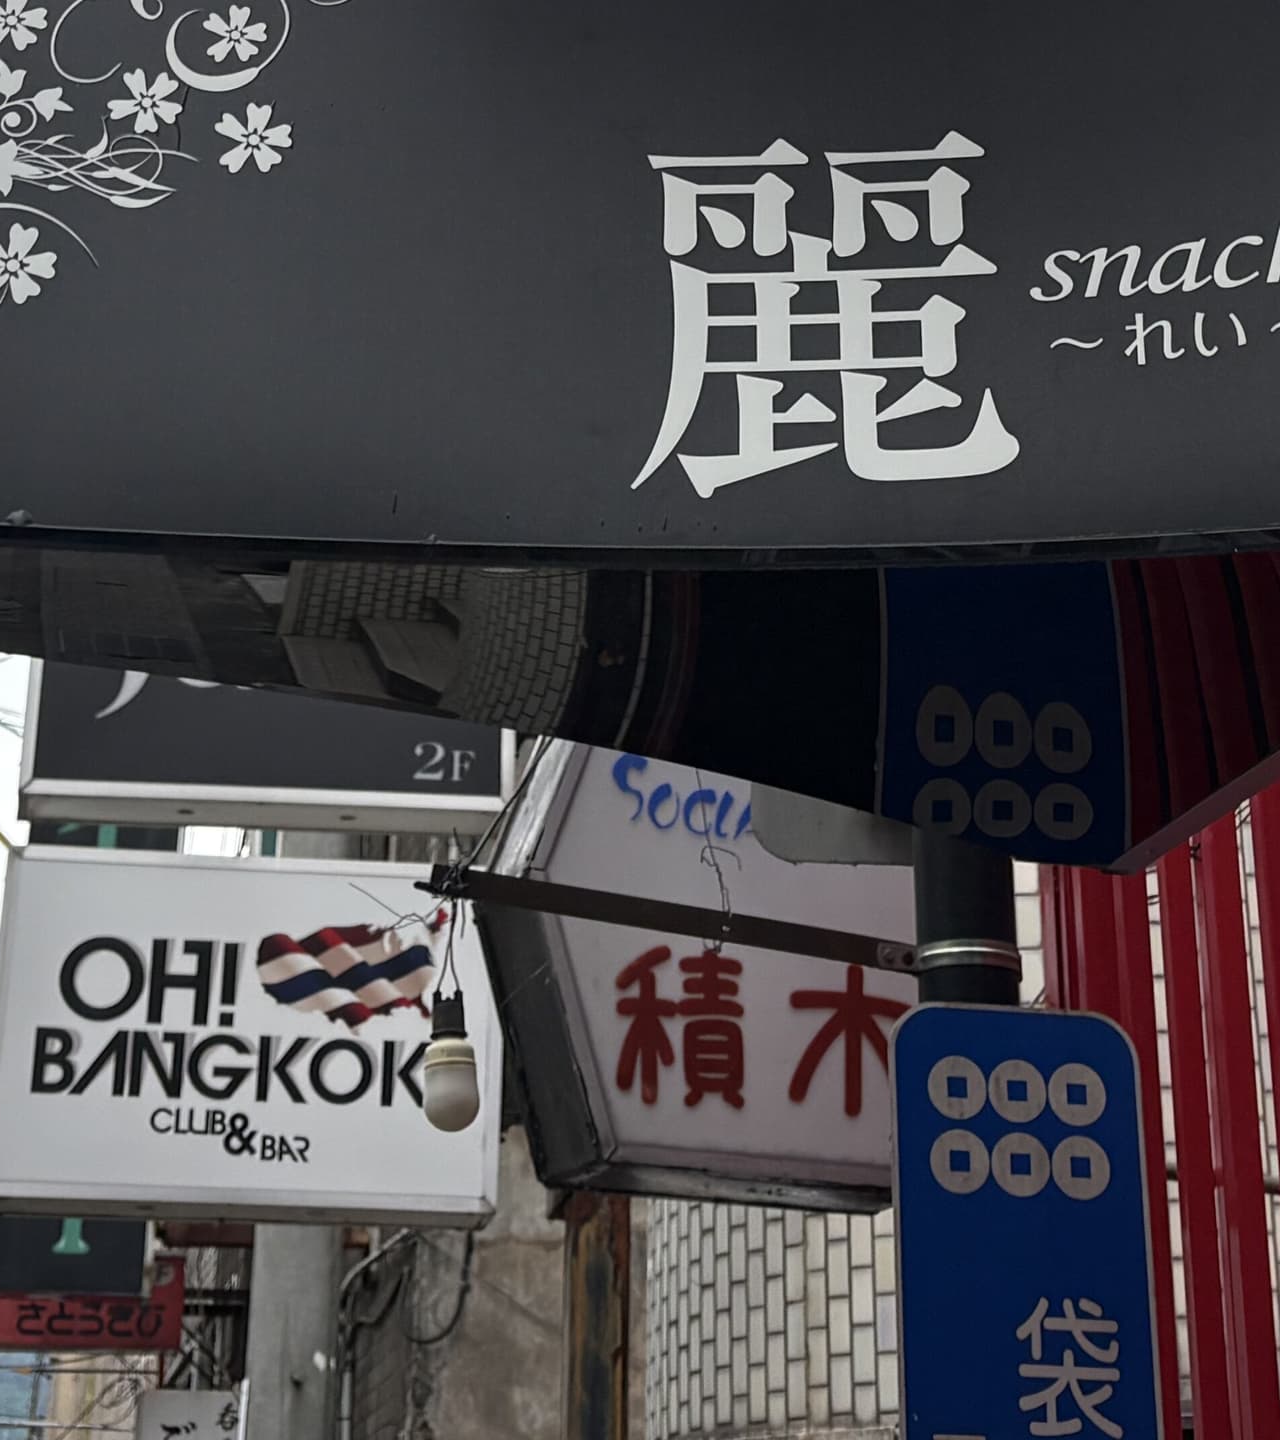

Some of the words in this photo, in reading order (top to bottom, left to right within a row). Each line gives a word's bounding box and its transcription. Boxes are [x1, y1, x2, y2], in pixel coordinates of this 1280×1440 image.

[630, 129, 1020, 500] 麗
[413, 742, 475, 781] 2F
[59, 936, 240, 1027] OH!
[30, 1026, 431, 1109] BANGKOK
[1016, 1296, 1124, 1440] 袋
